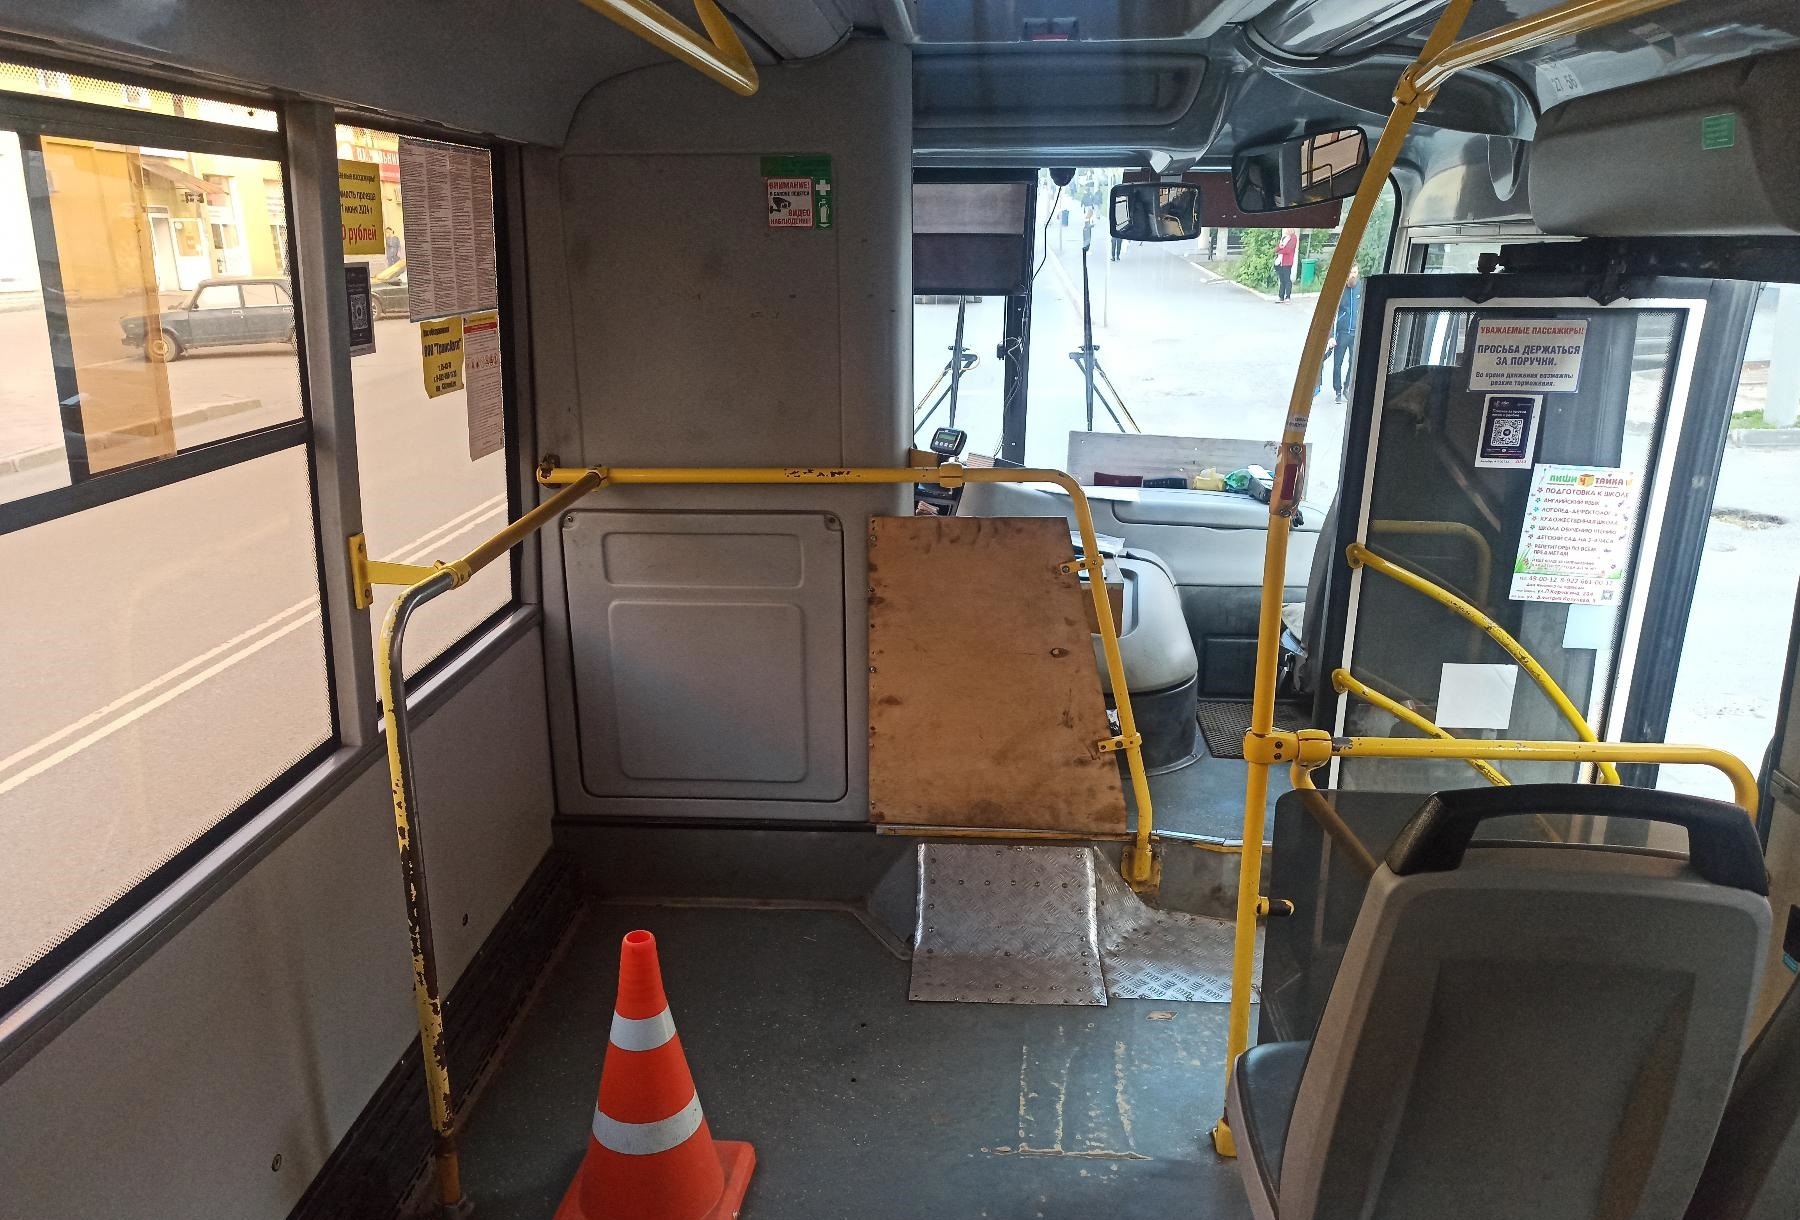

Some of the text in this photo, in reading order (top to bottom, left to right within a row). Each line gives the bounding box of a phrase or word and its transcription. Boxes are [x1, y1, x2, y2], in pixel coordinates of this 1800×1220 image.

[769, 181, 810, 190] ВНИМАНИЕ!
[356, 191, 376, 202] проезда
[788, 208, 811, 218] ВИДЕО
[348, 223, 377, 246] рублей
[1481, 326, 1584, 336] УВАЖАЕМЫЕ ПАССАЖИРЫ!
[1477, 344, 1581, 355] ПРОСЬБА ДЕРЖАТЬСЯ
[1495, 356, 1557, 366] ЗА ПОРУЧНИ.
[1485, 372, 1505, 380] время
[1506, 372, 1538, 380] движения
[1549, 474, 1578, 483] ПИШИ
[1545, 487, 1596, 497] ПОДГОТОВКА
[1603, 490, 1629, 498] ШКОЛЕ
